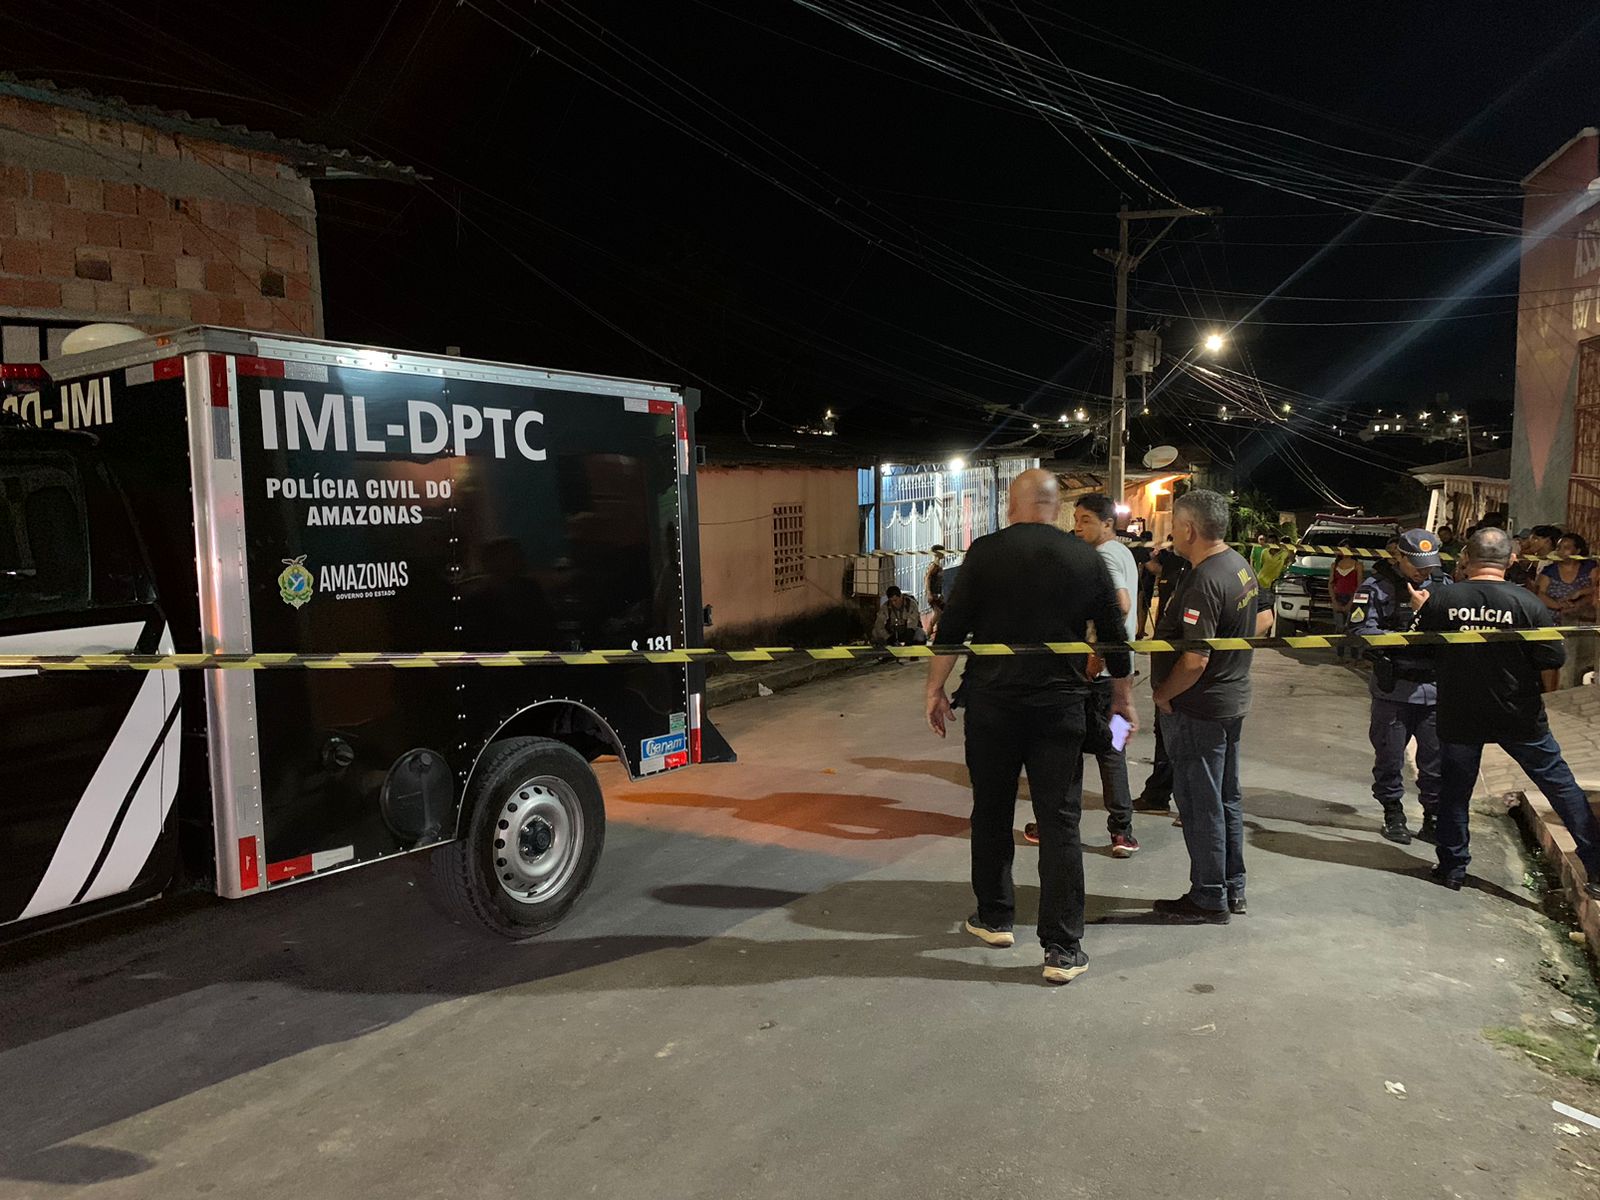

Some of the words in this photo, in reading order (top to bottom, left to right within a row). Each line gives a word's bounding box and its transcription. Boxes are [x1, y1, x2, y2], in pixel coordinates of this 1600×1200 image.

[259, 389, 547, 461] IML-DPTC
[266, 472, 360, 499] POLÍCIA
[365, 479, 420, 499] CIVIL
[425, 480, 452, 499] DO
[306, 505, 423, 526] AMAZONAS
[320, 561, 408, 592] AMAZONAS
[335, 592, 364, 600] GOVERNO
[374, 589, 396, 597] ESTADO
[1448, 605, 1514, 624] POLÍCIA
